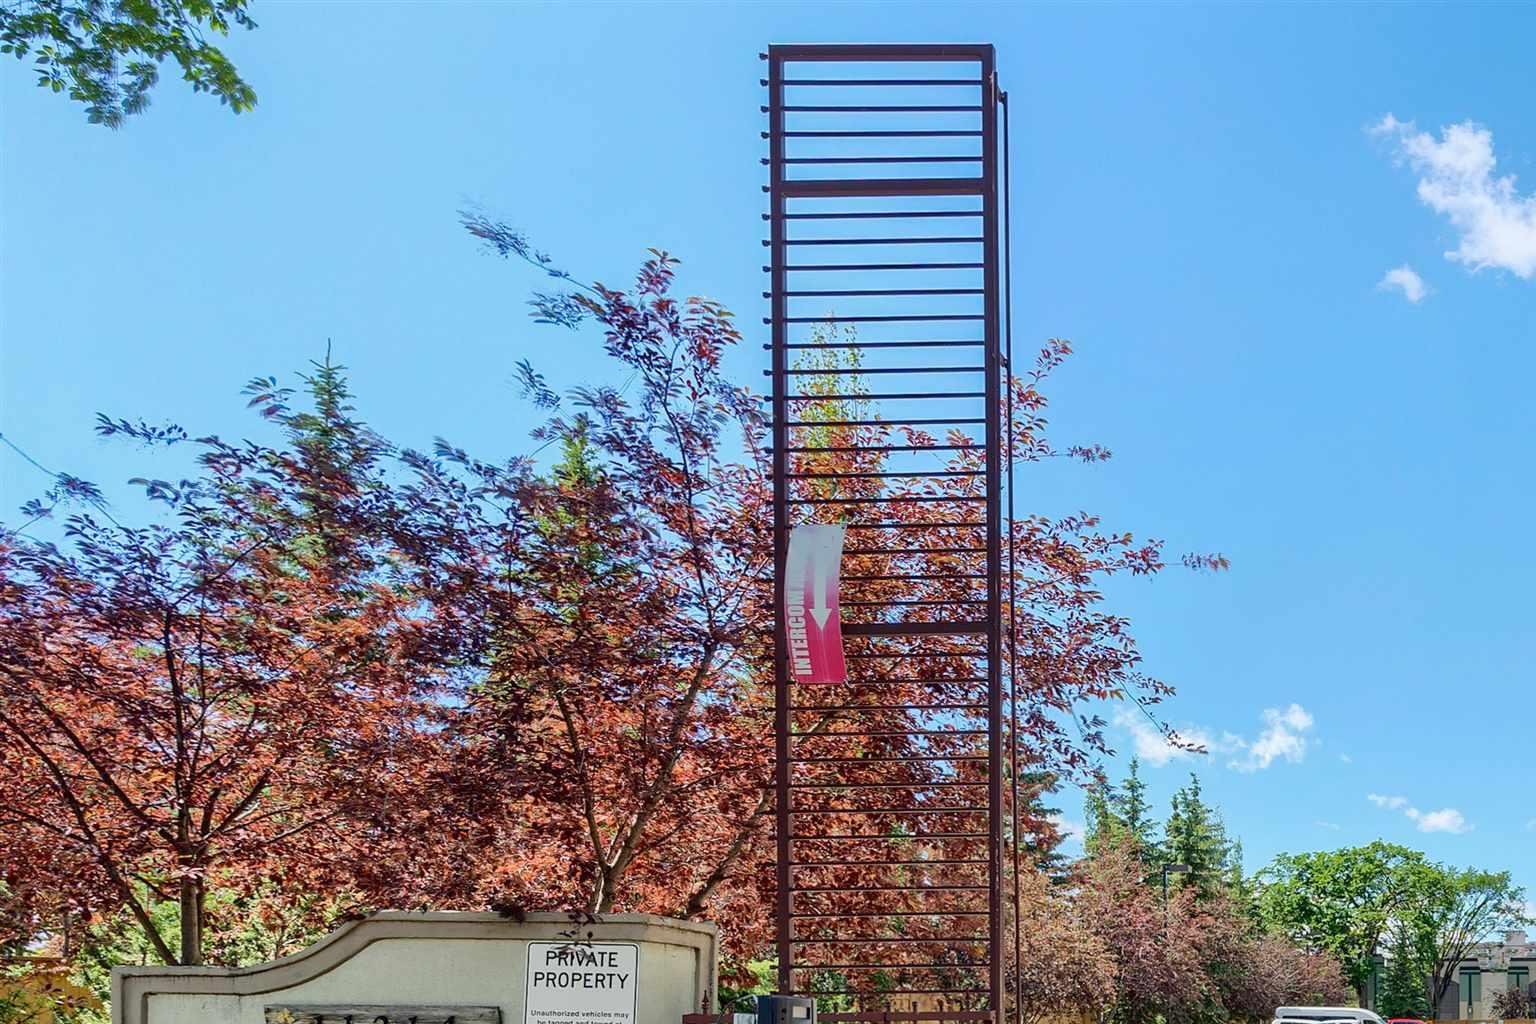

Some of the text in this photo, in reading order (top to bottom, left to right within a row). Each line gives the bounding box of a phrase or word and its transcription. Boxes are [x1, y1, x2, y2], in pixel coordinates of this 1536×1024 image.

[788, 591, 813, 675] INTERCOM
[546, 950, 618, 967] PRIVATE
[534, 972, 629, 989] PROPERTY
